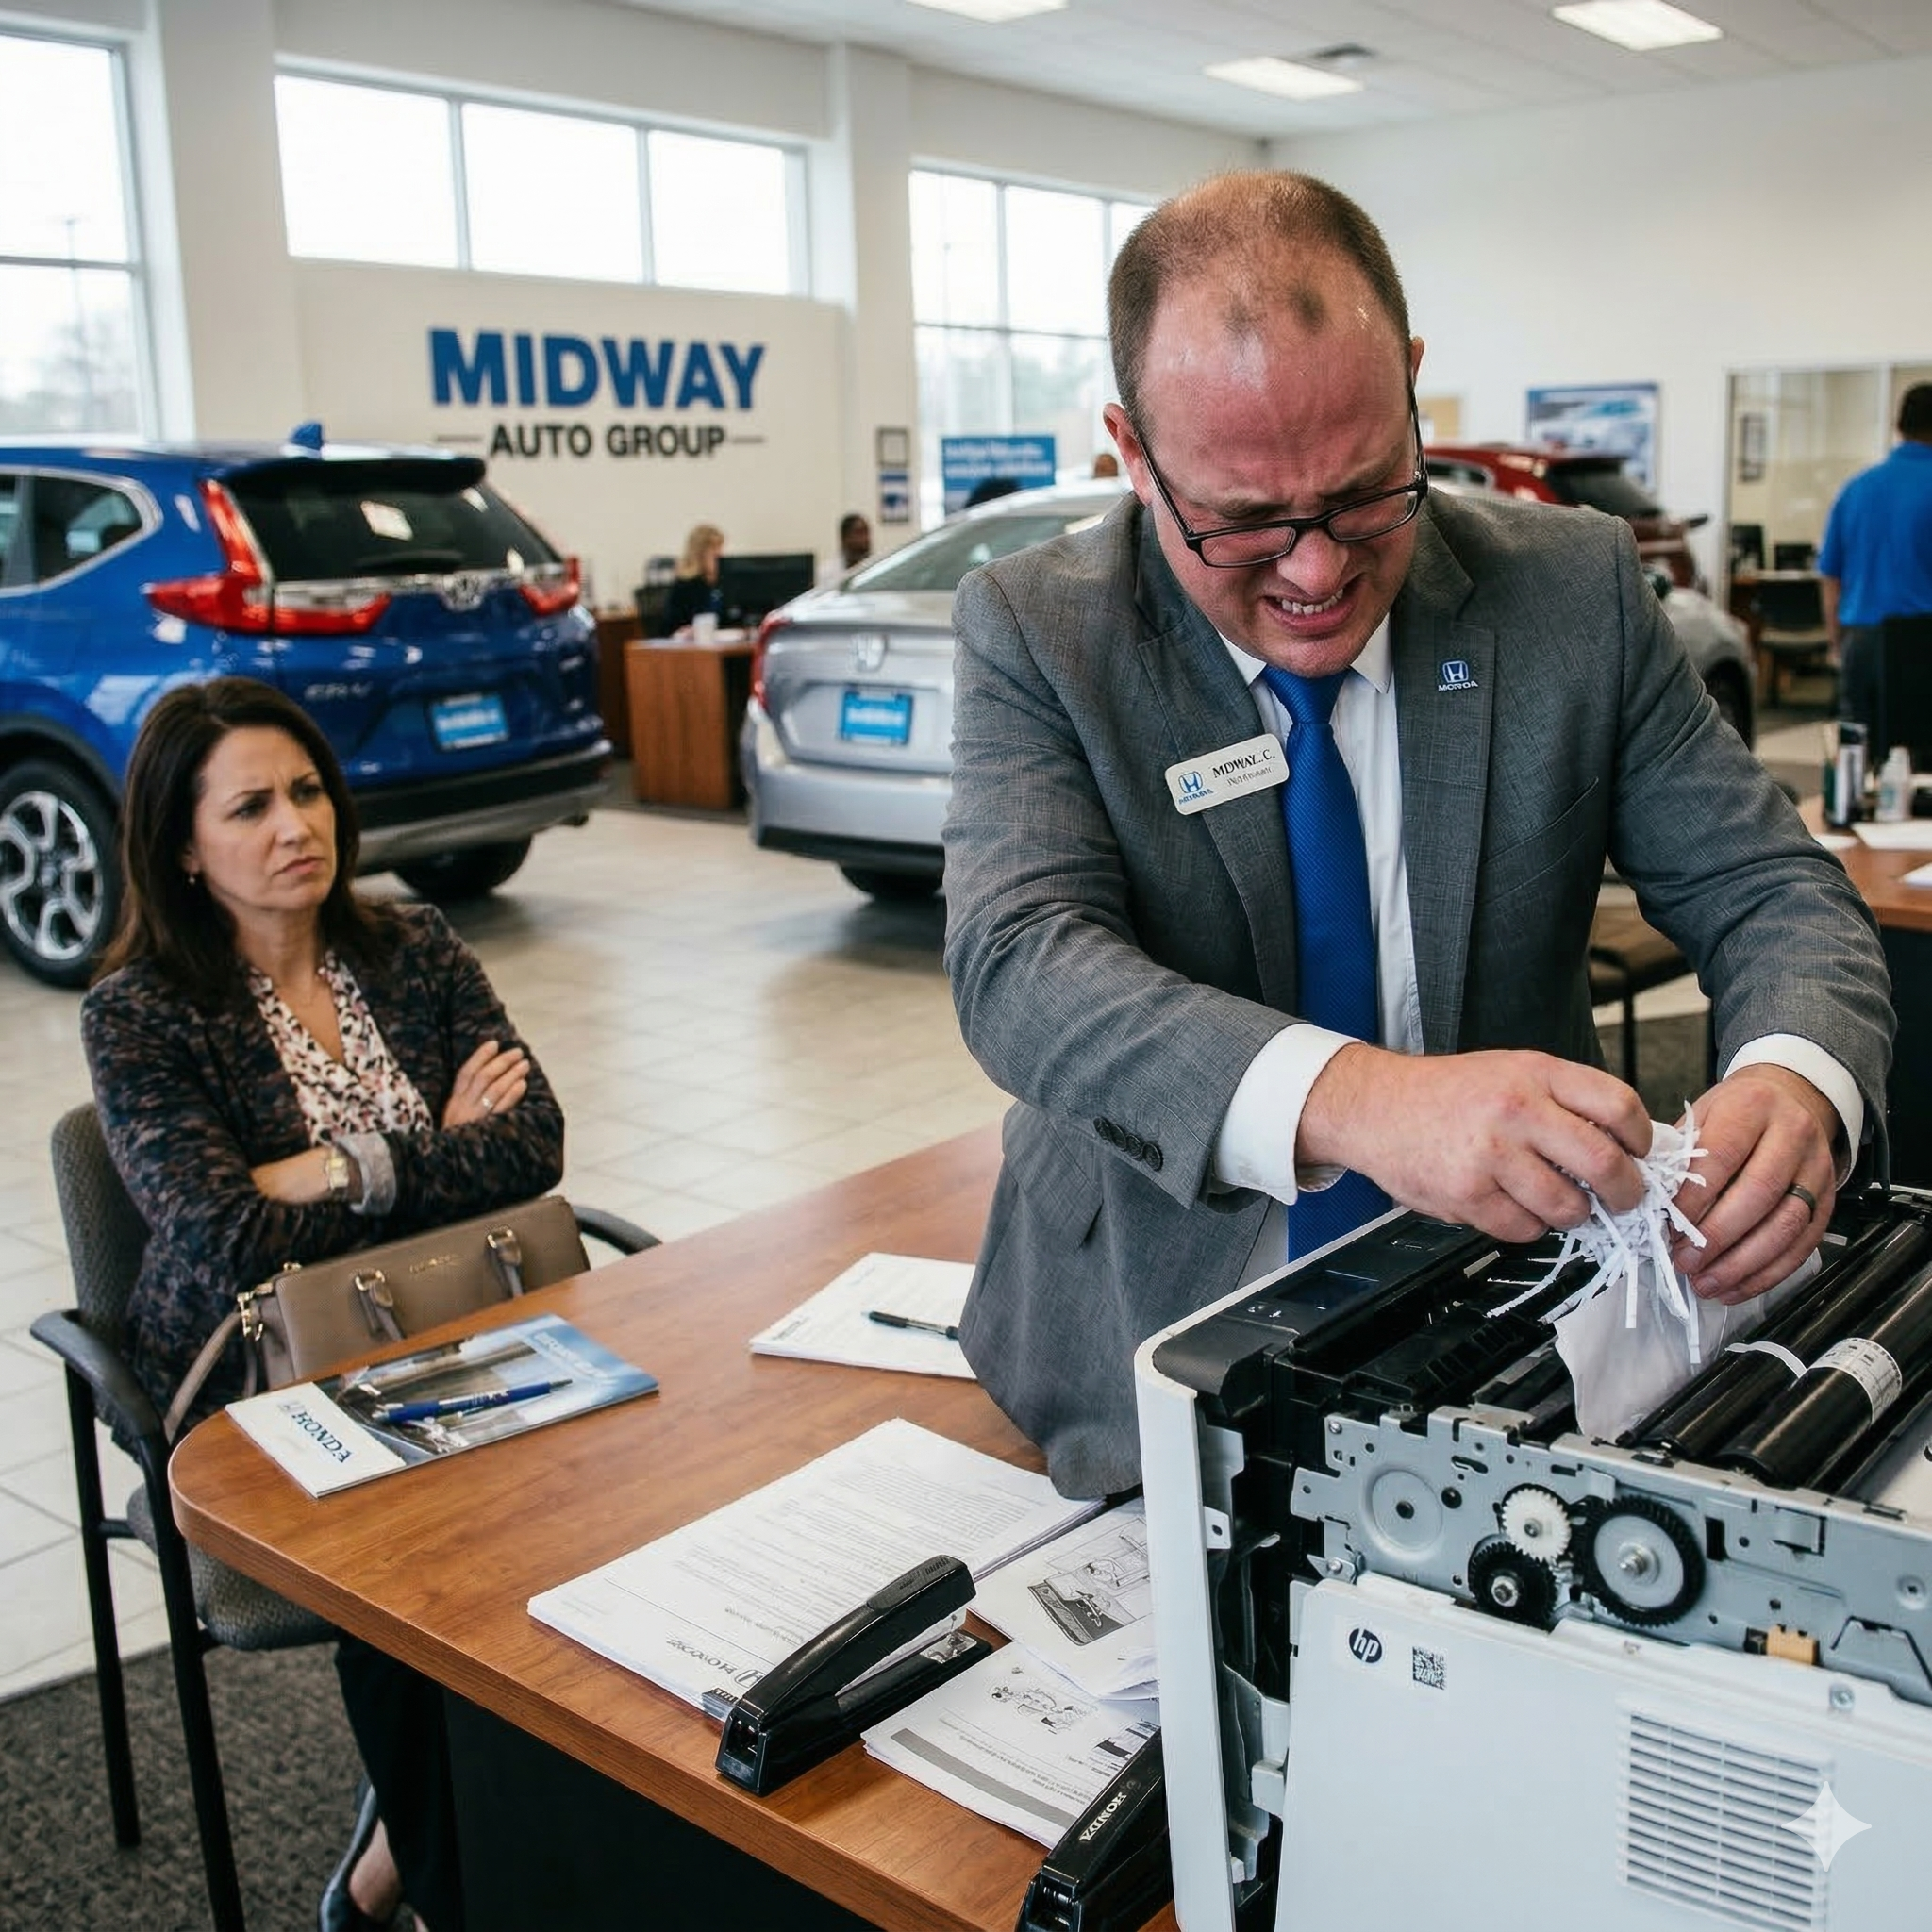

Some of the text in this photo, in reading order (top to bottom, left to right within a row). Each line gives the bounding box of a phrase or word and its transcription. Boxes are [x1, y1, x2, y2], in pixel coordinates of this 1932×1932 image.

[430, 330, 765, 409] MIDWAY
[491, 425, 726, 458] AUTO GROUP
[1350, 1627, 1382, 1663] hp
